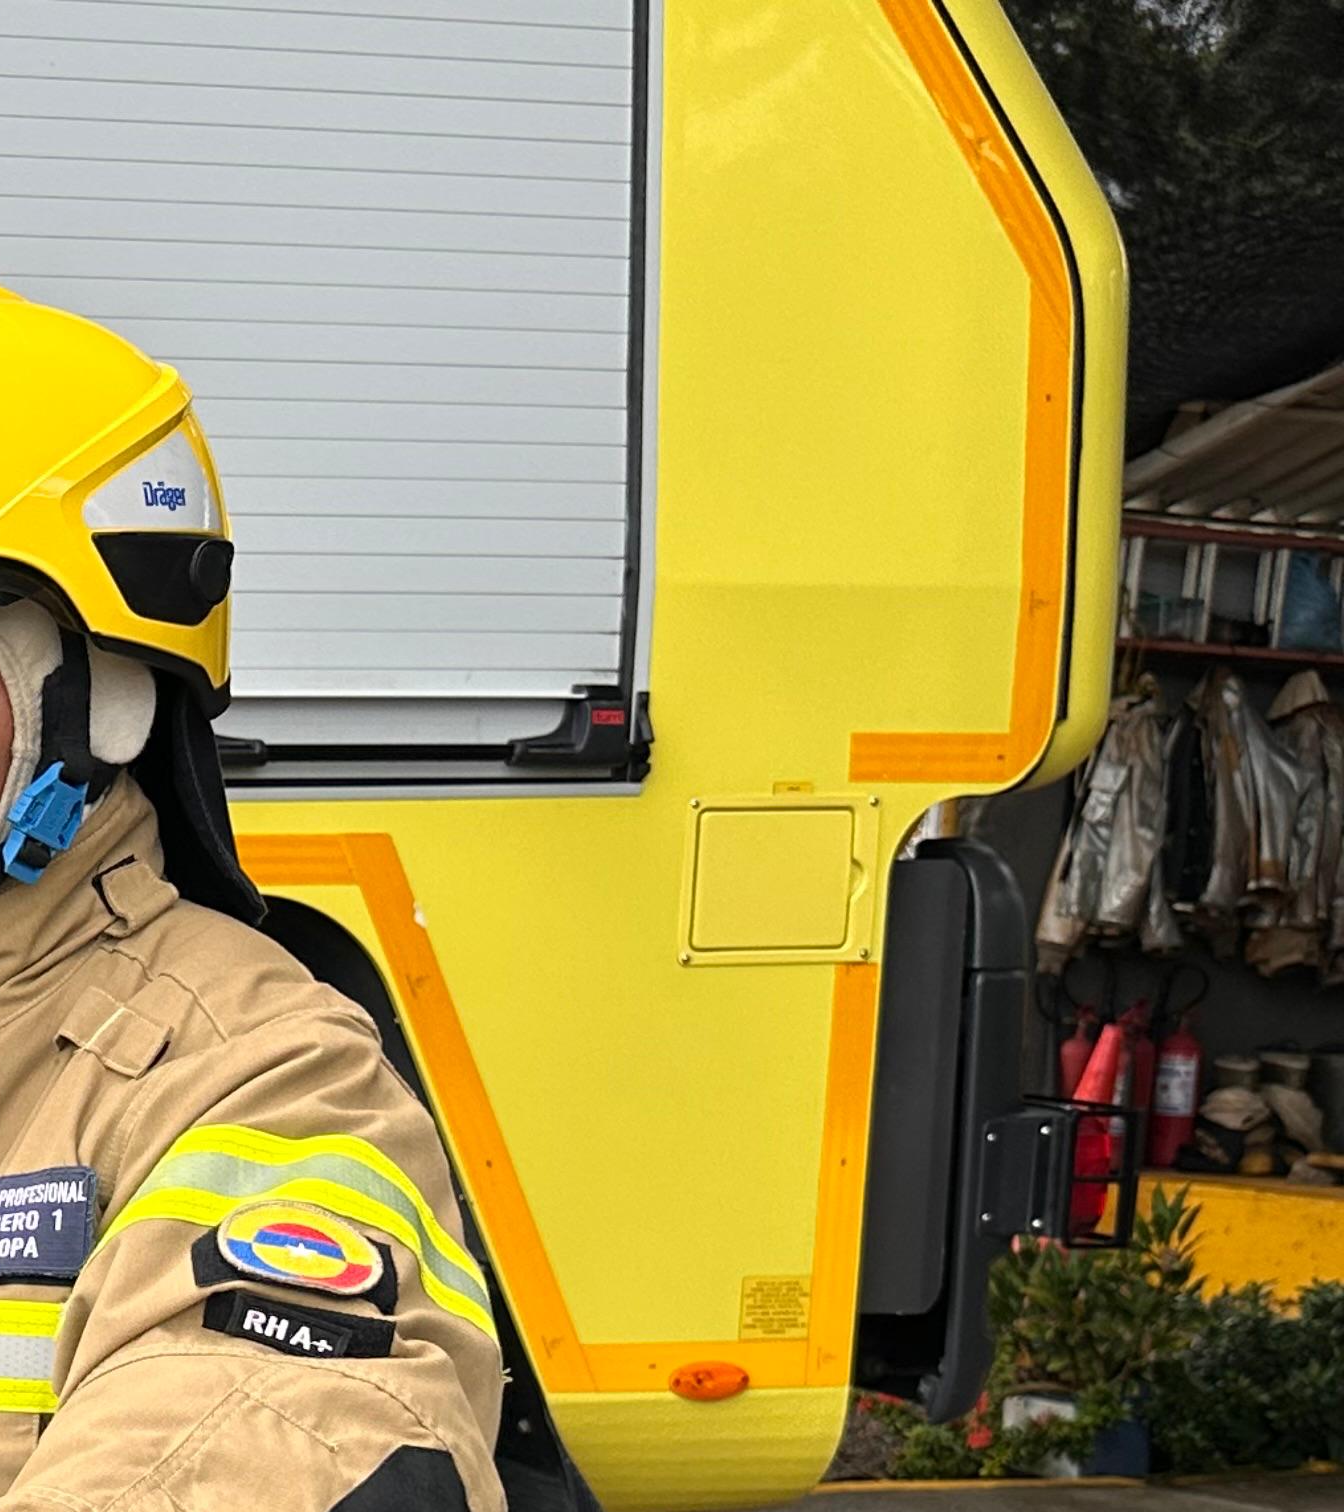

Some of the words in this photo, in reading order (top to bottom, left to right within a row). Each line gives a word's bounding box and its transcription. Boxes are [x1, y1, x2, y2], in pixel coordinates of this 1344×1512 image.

[142, 481, 186, 511] Dräger
[51, 1208, 63, 1231] 1
[242, 1309, 289, 1341] RH
[289, 1326, 333, 1353] A+
